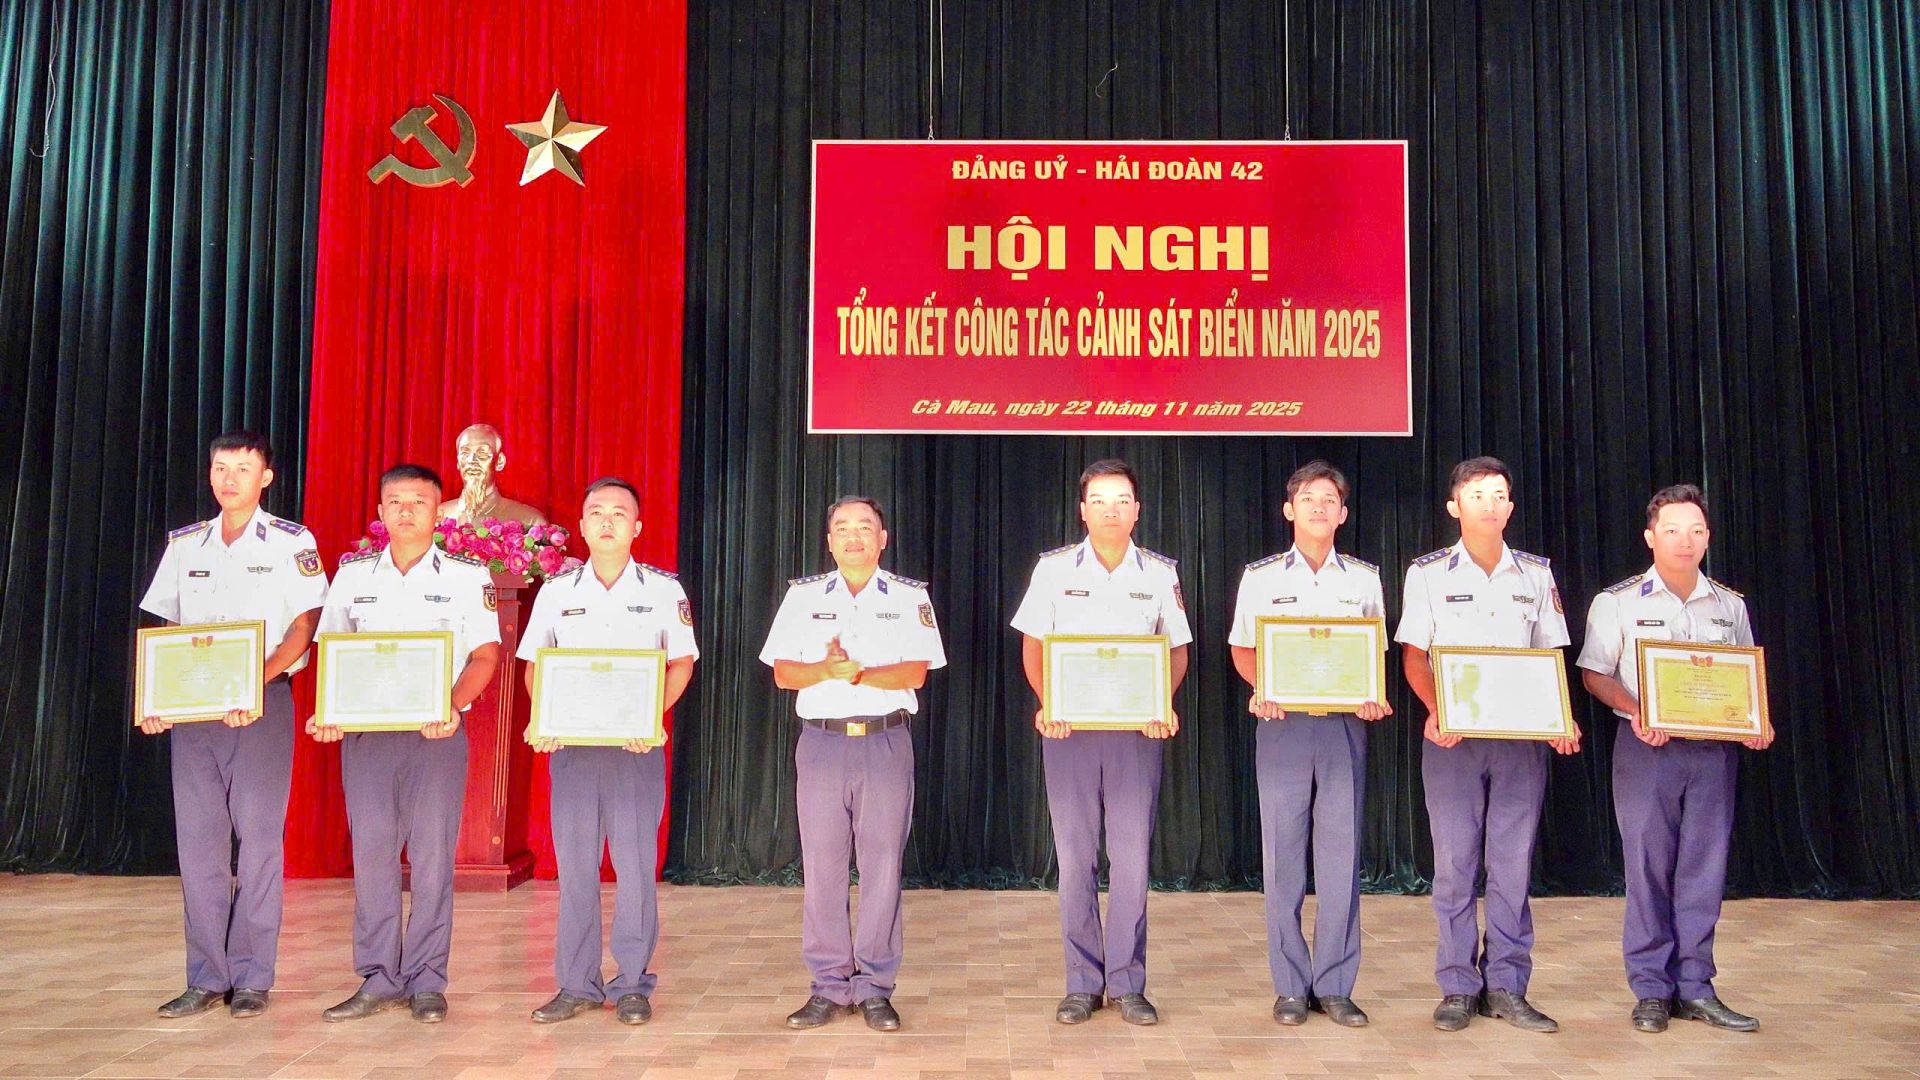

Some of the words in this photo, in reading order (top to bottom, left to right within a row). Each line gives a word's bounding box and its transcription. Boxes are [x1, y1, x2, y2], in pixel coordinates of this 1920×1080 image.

[951, 154, 1026, 180] ĐẢNG
[1034, 154, 1069, 180] UỶ
[1095, 154, 1140, 180] HẢI
[1148, 157, 1222, 181] ĐOÀN
[1230, 161, 1263, 180] 42
[947, 215, 1066, 281] HỘI
[1094, 225, 1270, 282] NGHỊ
[836, 286, 898, 356] TỔNG
[904, 291, 948, 357] KẾT
[954, 297, 1019, 357] CÔNG
[1025, 297, 1070, 357] TÁC
[1077, 290, 1141, 357] CẢNH
[1148, 298, 1193, 358] SÁT
[1199, 287, 1255, 357] BIỂN
[1261, 298, 1317, 358] NĂM
[1323, 308, 1381, 358] 2025
[911, 399, 942, 415] Cà
[944, 399, 998, 416] Mau,
[1003, 399, 1060, 417] ngày
[1060, 400, 1092, 415] 22
[1094, 399, 1158, 417] tháng
[1163, 401, 1189, 416] 11
[1192, 400, 1243, 416] năm
[1245, 401, 1304, 416] 2025
